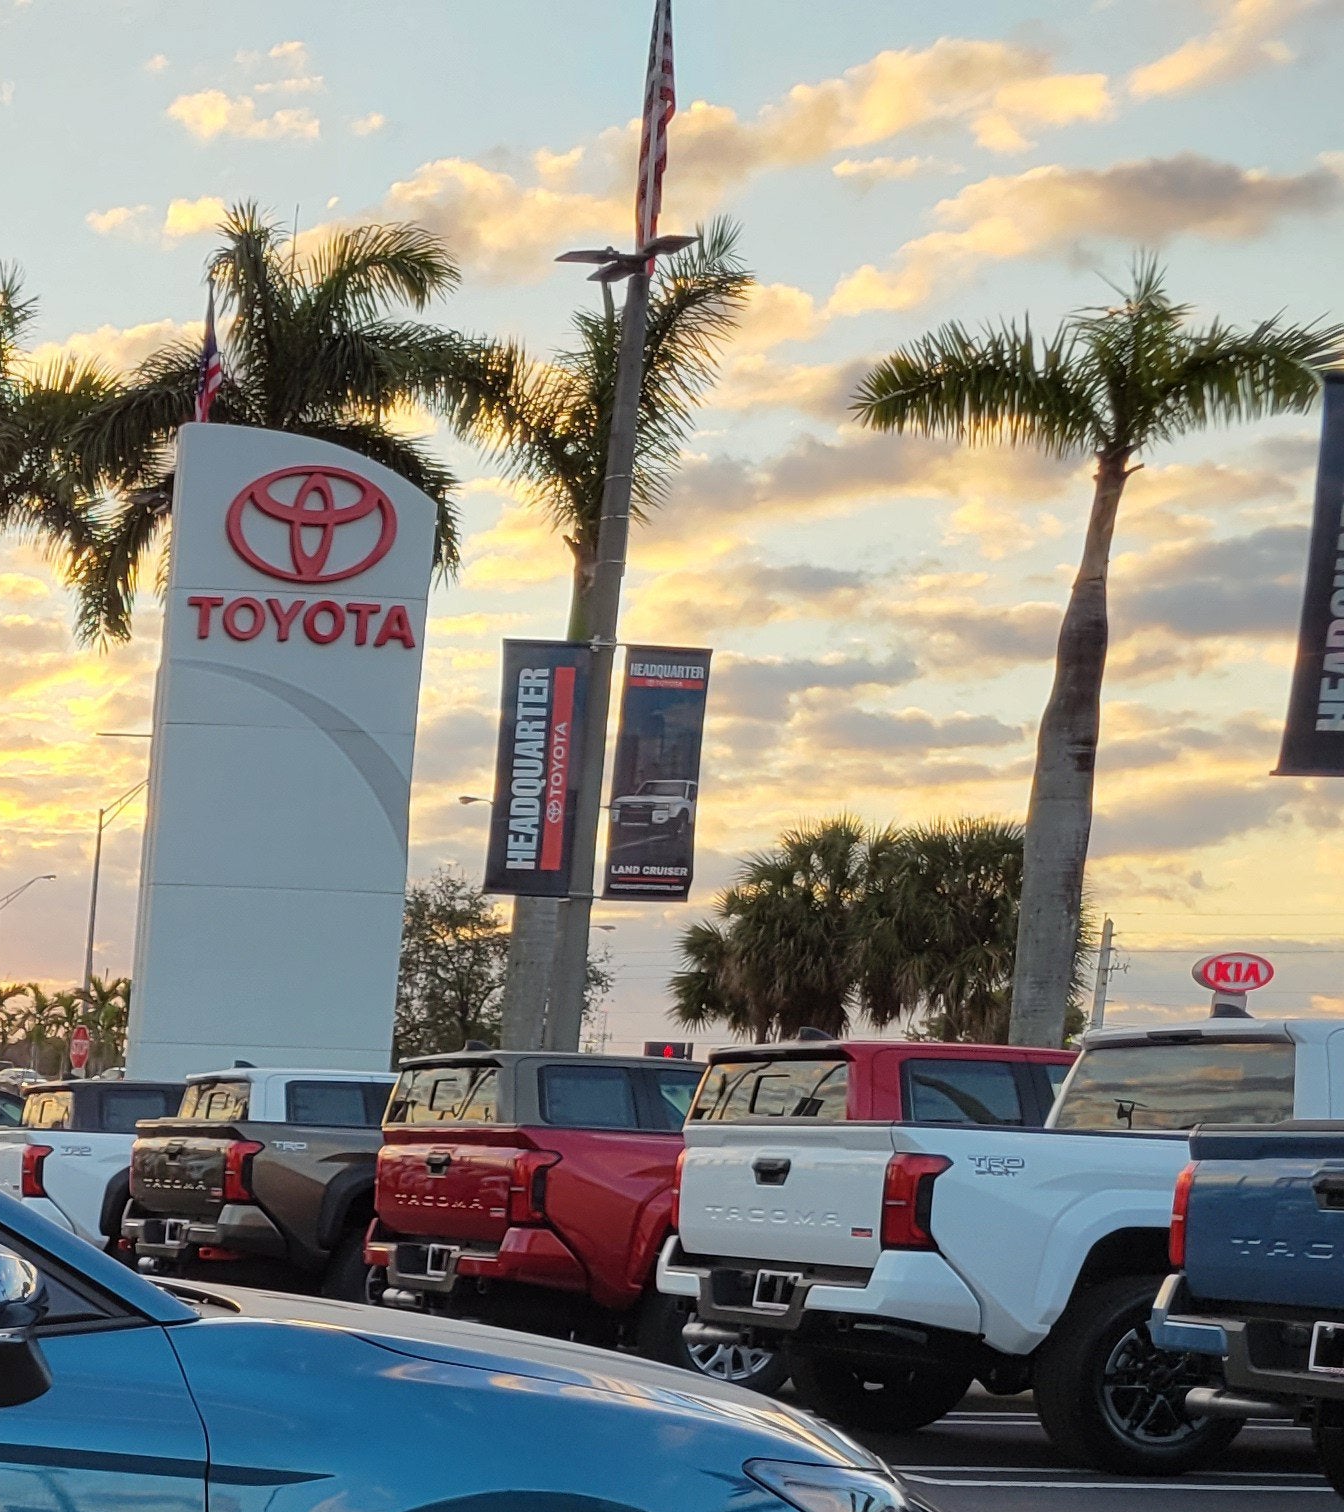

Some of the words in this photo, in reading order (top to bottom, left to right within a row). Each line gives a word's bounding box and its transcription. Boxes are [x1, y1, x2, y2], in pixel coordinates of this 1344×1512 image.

[187, 596, 416, 649] TOYOTA
[630, 662, 705, 679] HEADQUARTER
[505, 667, 550, 871] HEADQUARTER
[548, 721, 568, 799] TOYOTA
[611, 865, 640, 874] LAND
[642, 866, 688, 876] CRUISER
[1214, 961, 1261, 983] KIA
[269, 1140, 308, 1151] TRD
[968, 1156, 1025, 1172] TRD
[143, 1178, 207, 1191] TACOMA
[394, 1193, 484, 1210] TACOMA
[704, 1205, 842, 1227] TACOMA
[1231, 1238, 1344, 1260] TAC
